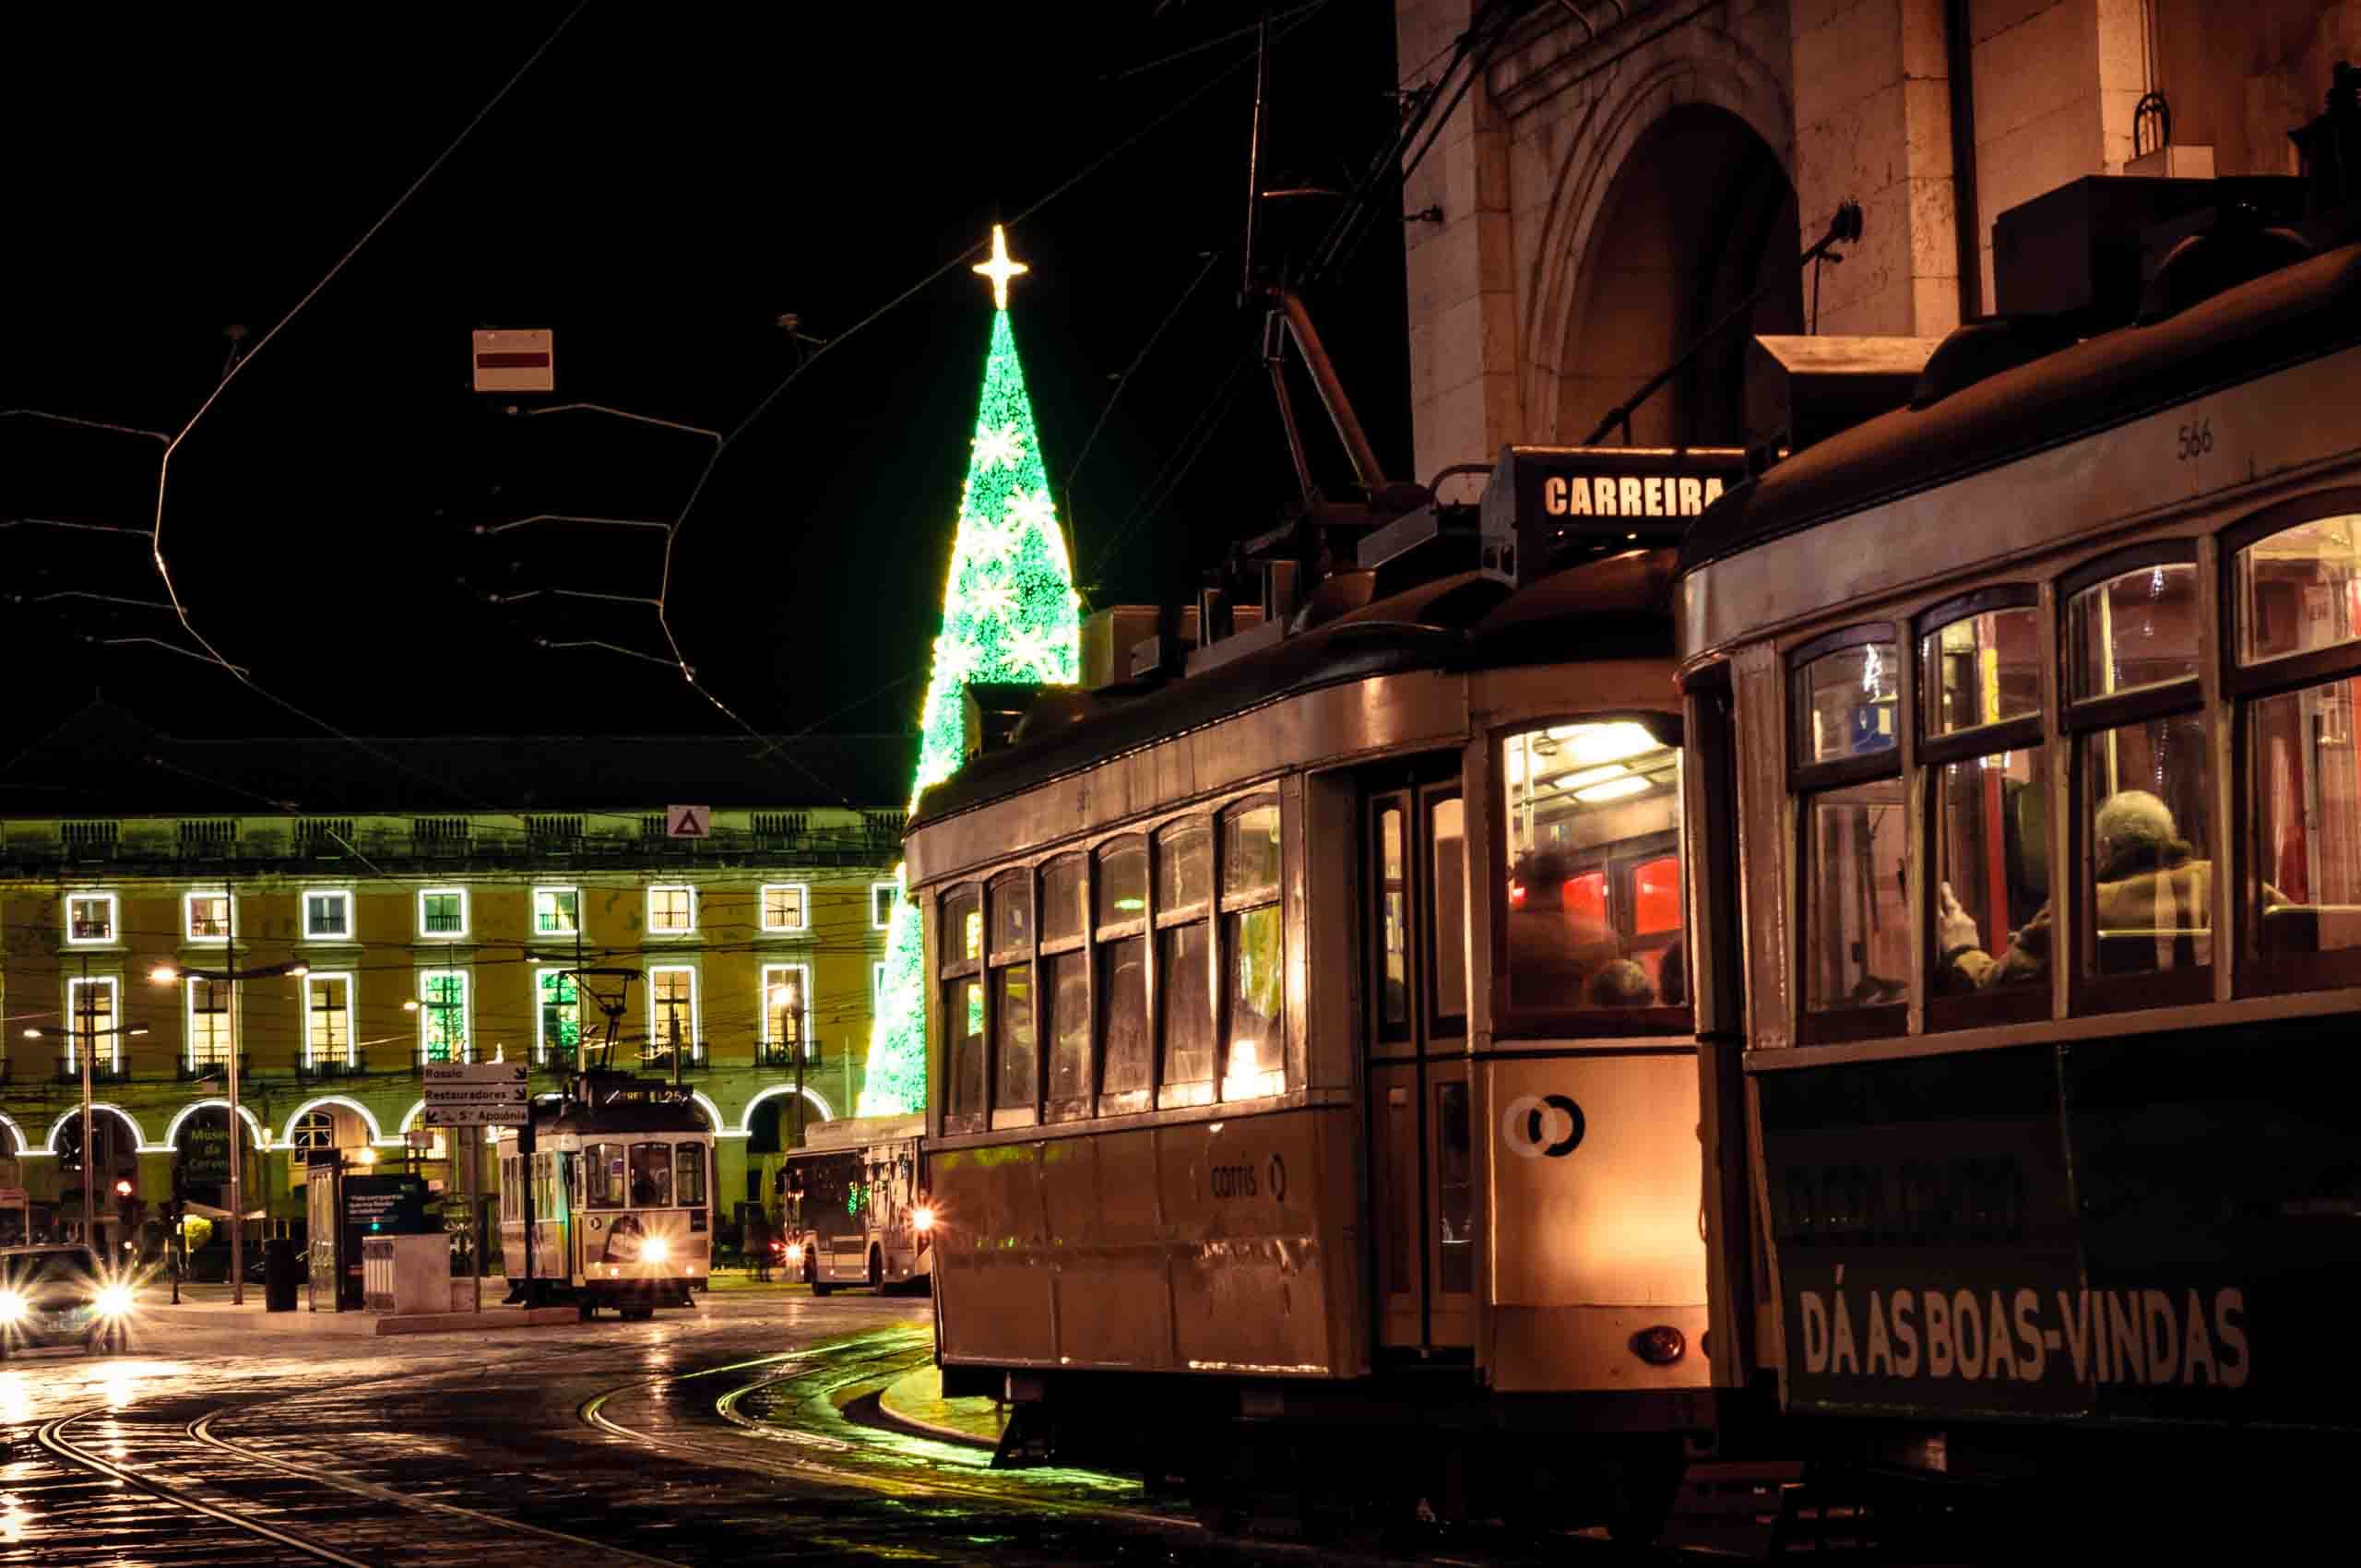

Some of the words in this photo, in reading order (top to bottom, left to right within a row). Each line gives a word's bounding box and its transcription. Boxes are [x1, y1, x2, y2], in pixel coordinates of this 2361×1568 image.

[2177, 415, 2213, 459] 566
[425, 1089, 506, 1100] Restauradores
[1799, 1262, 1860, 1374] DÁ
[1865, 1286, 1919, 1380] AS
[1922, 1285, 2250, 1387] BOAS-VINDAS
